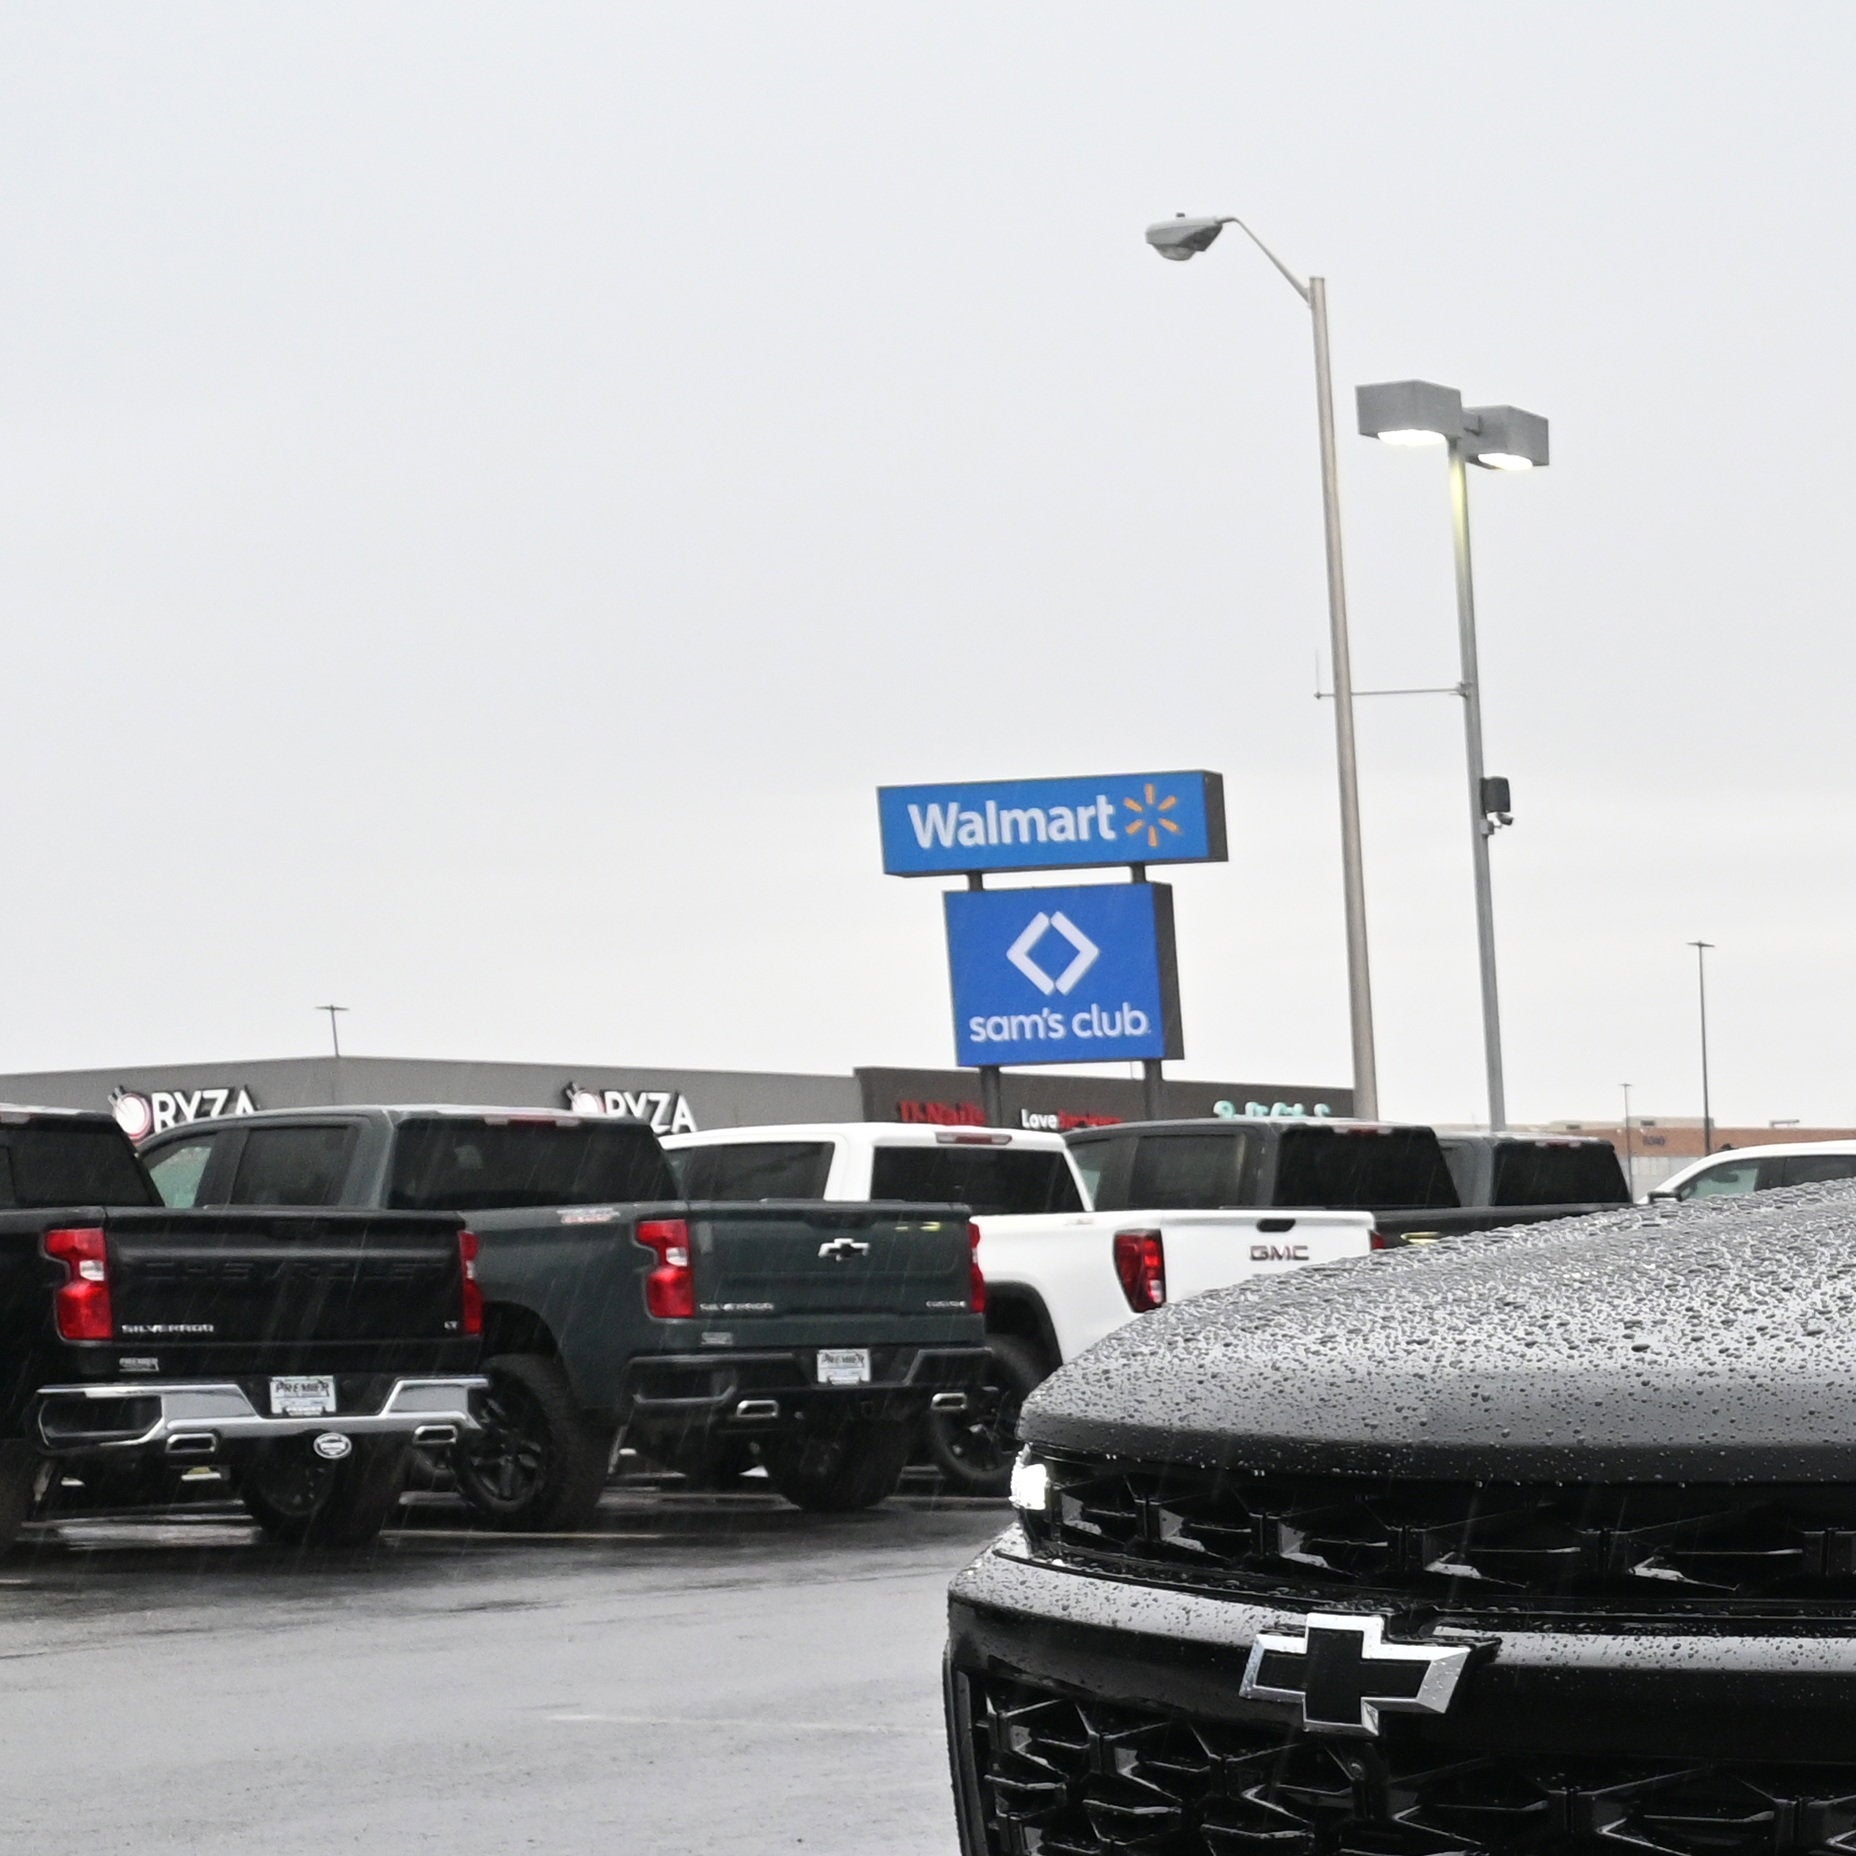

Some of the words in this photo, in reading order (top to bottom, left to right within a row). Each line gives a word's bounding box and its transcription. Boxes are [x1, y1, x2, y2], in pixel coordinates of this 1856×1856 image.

[907, 795, 1116, 848] Walmart
[969, 1007, 1066, 1042] sam's
[1072, 1002, 1149, 1038] club
[1250, 1245, 1309, 1261] GMC
[122, 1323, 215, 1334] SILVERADO
[276, 1380, 330, 1397] PREMIER
